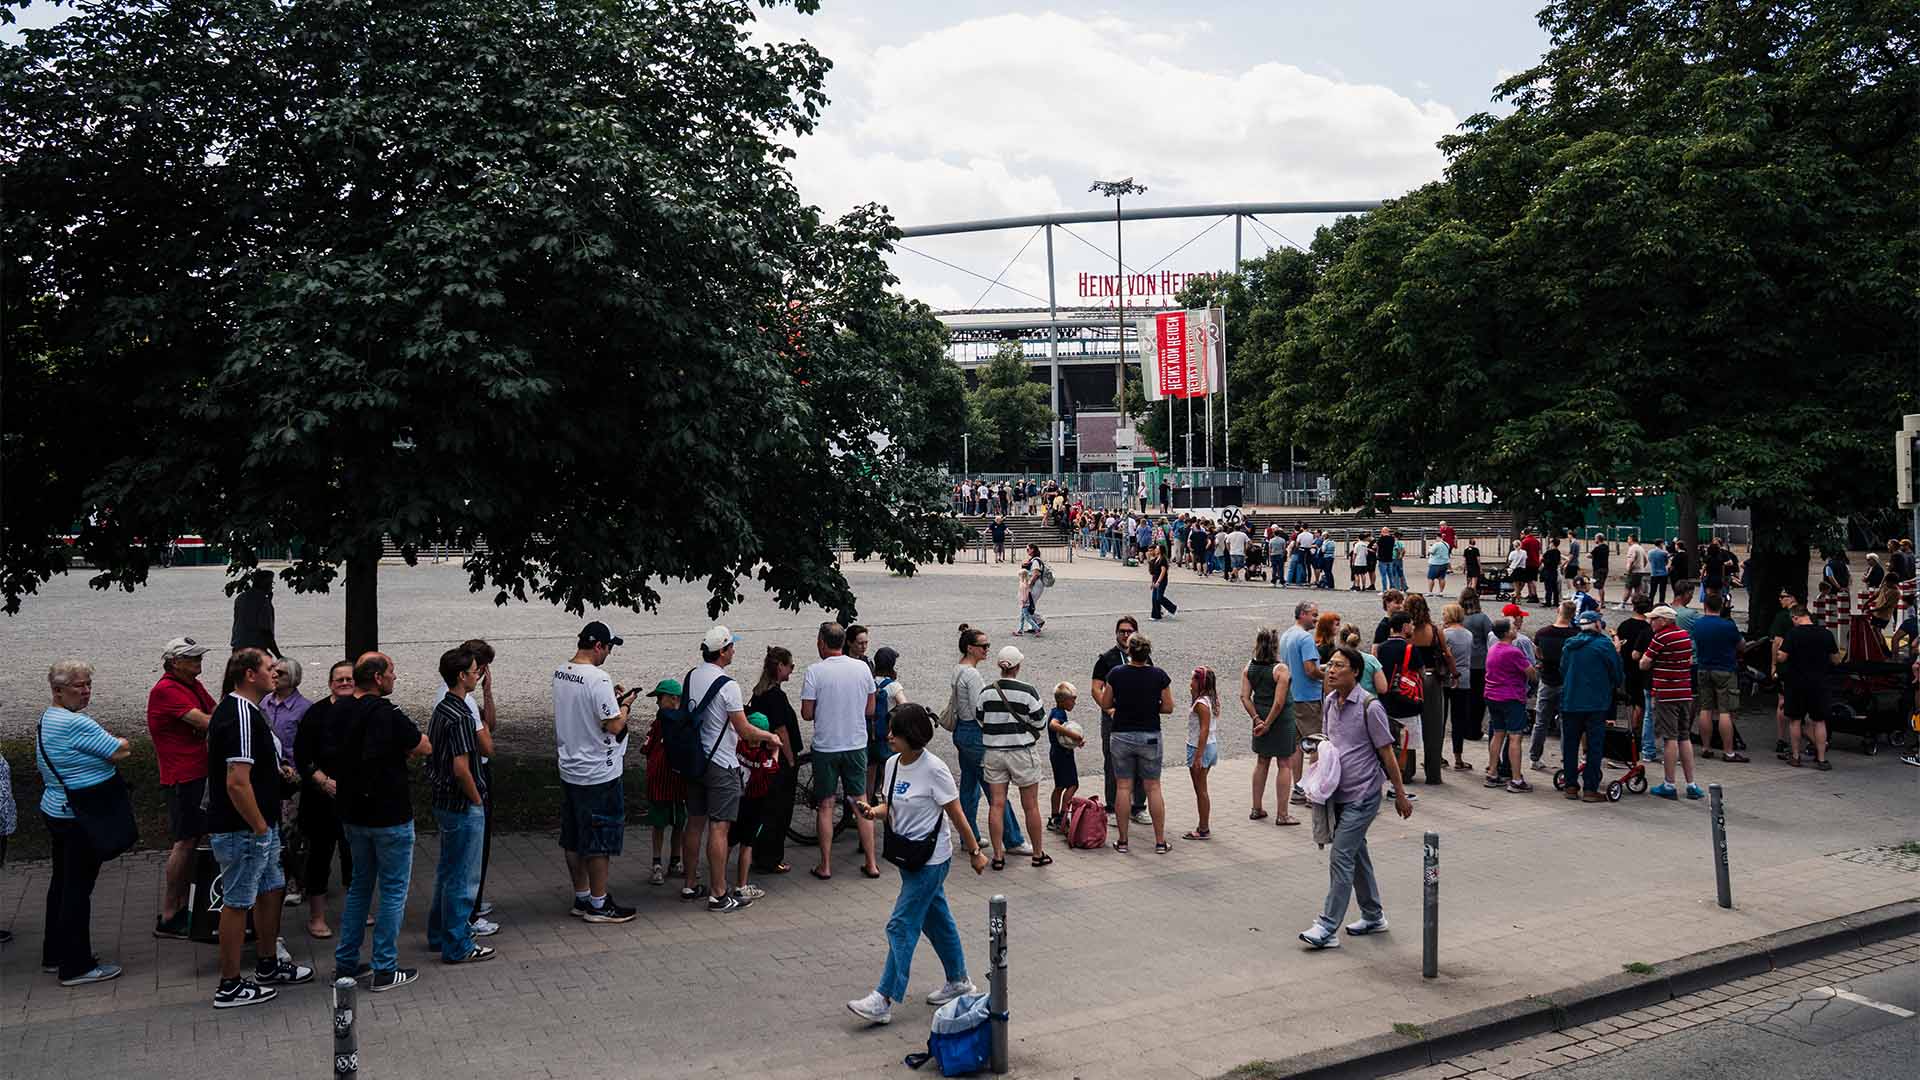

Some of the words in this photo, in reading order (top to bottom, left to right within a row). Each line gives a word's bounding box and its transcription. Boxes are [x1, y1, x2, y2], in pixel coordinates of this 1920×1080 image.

[1079, 272, 1121, 297] HEINZ
[1128, 274, 1156, 296] VON
[1224, 509, 1240, 523] 96
[554, 670, 585, 685] ROVINZIAL
